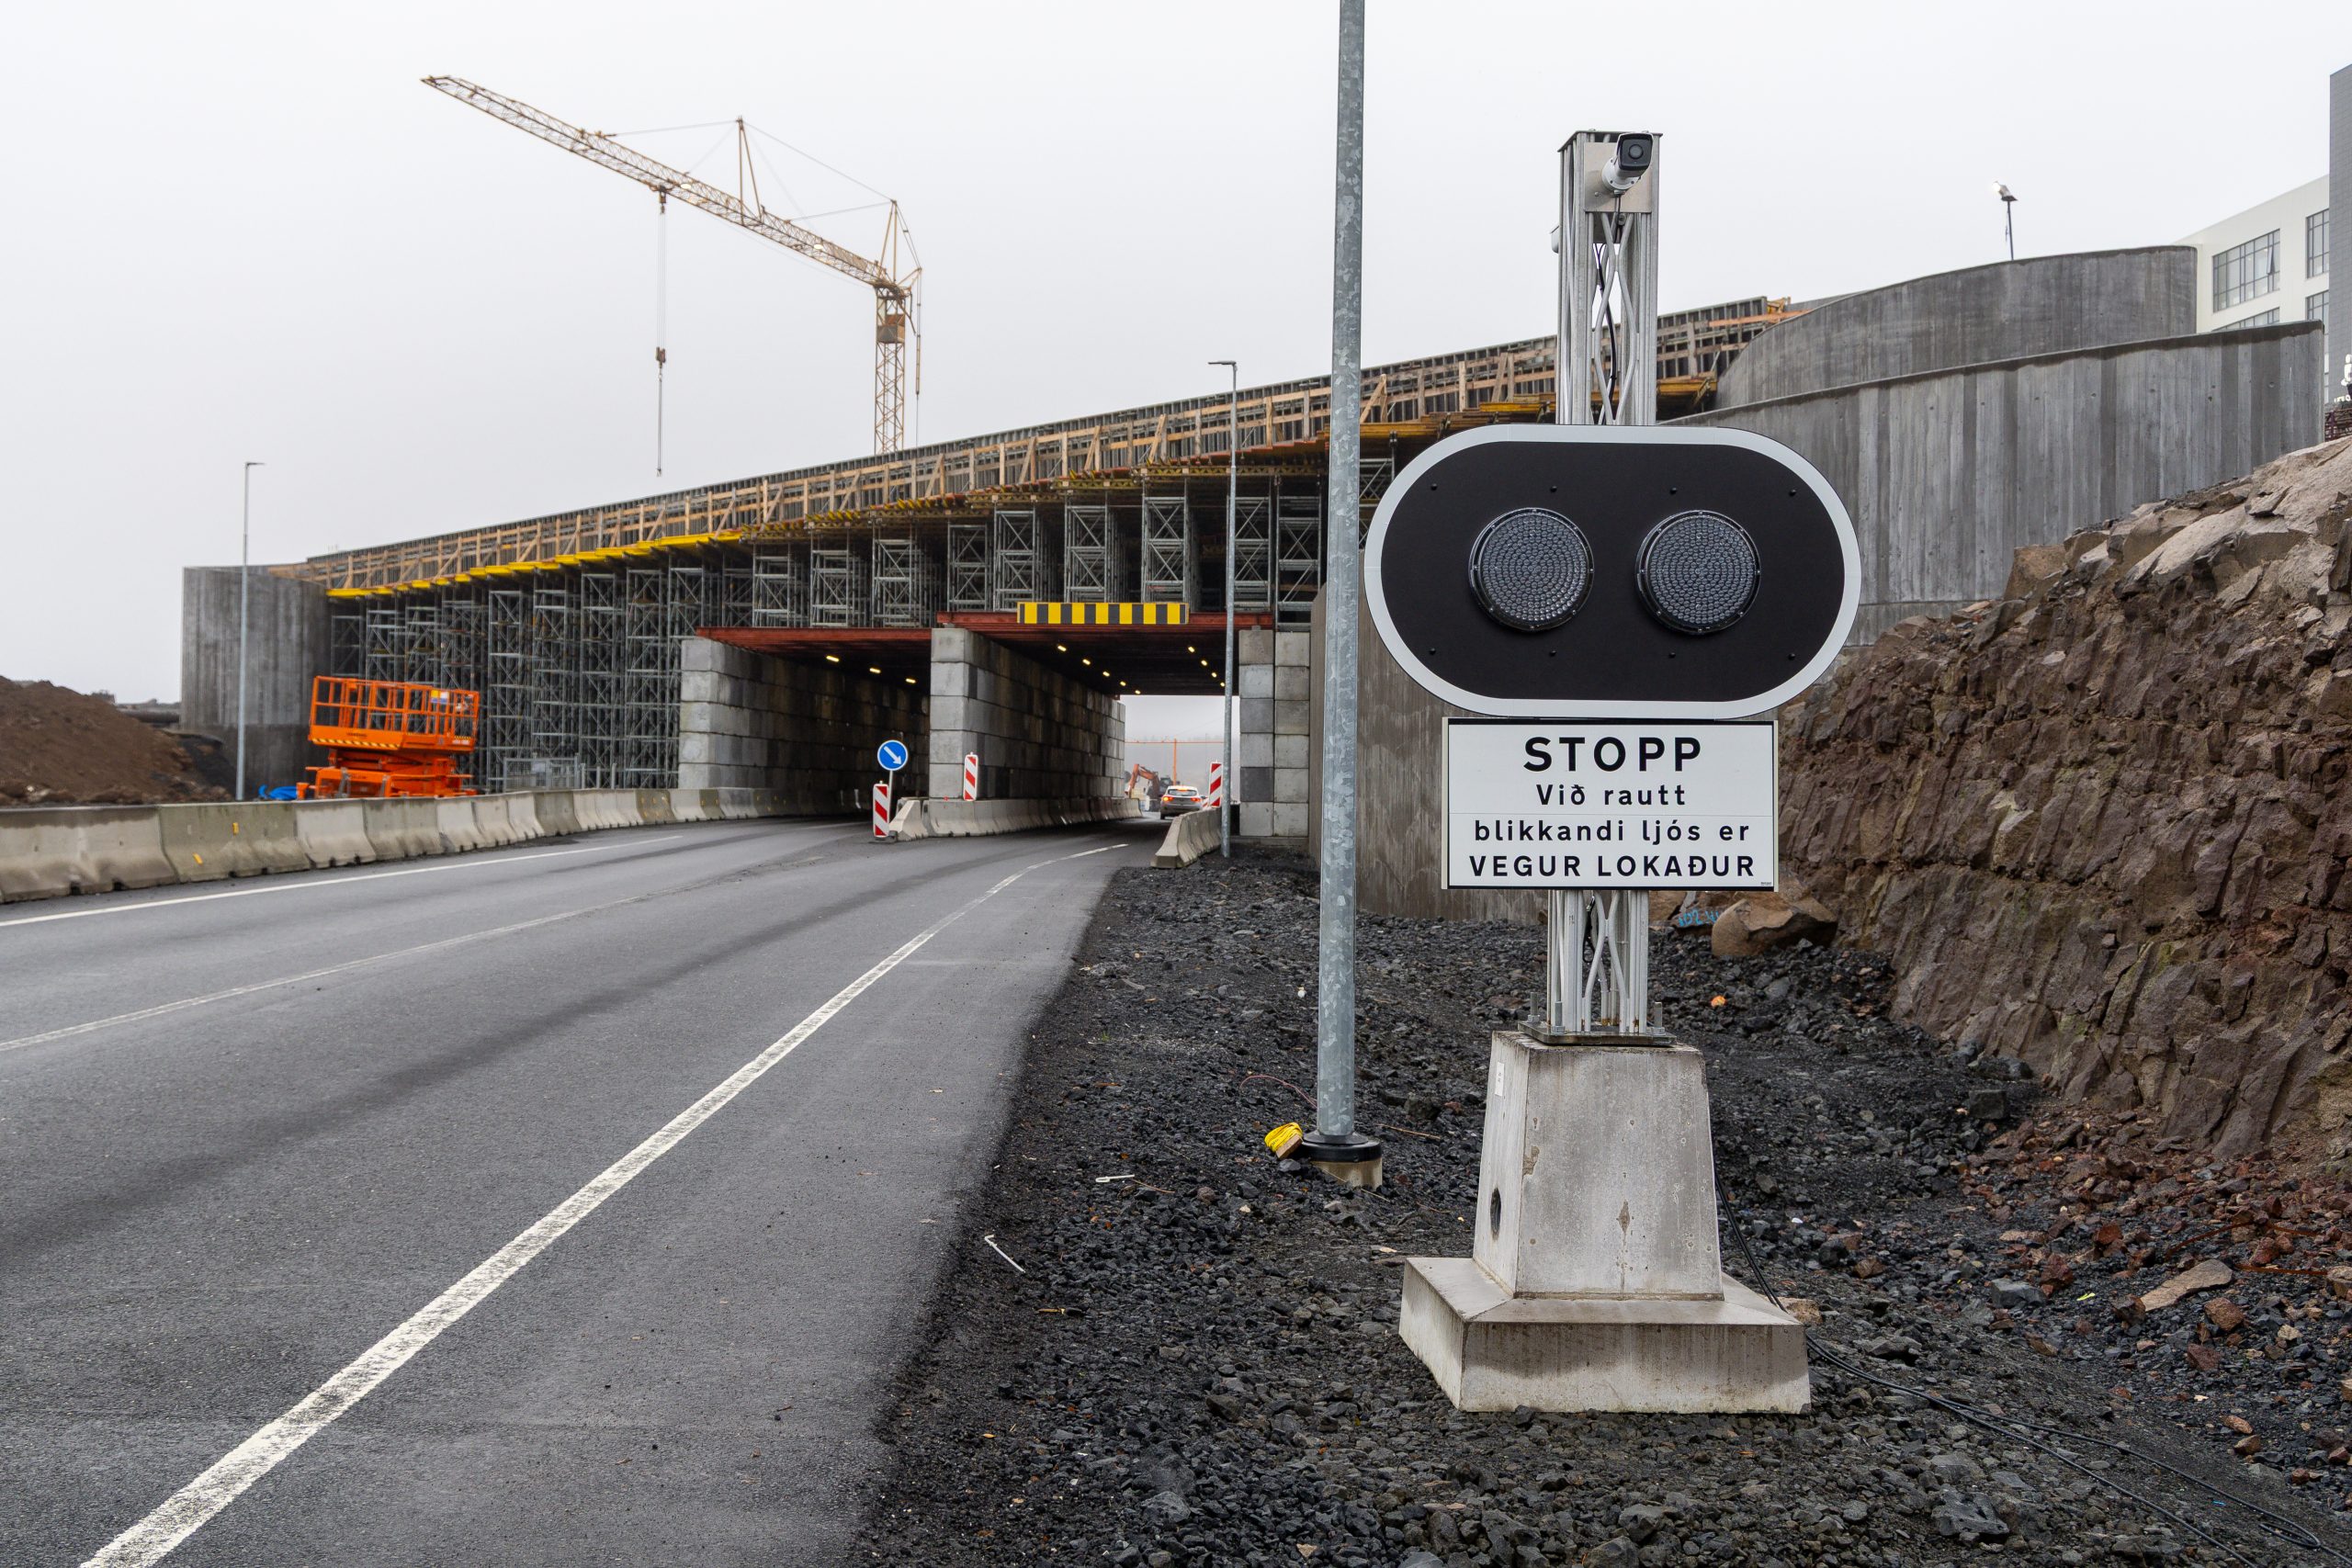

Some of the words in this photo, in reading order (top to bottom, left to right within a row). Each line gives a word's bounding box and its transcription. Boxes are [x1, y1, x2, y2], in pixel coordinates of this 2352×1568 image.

[1523, 736, 1702, 773] STOPP
[1535, 784, 1586, 806] Við
[1604, 784, 1686, 806] rautt
[1475, 819, 1624, 841] blikkandi
[1642, 818, 1701, 846] ljós
[1719, 825, 1749, 841] er
[1468, 855, 1581, 877] VEGUR
[1598, 855, 1754, 877] LOKAÐUR
